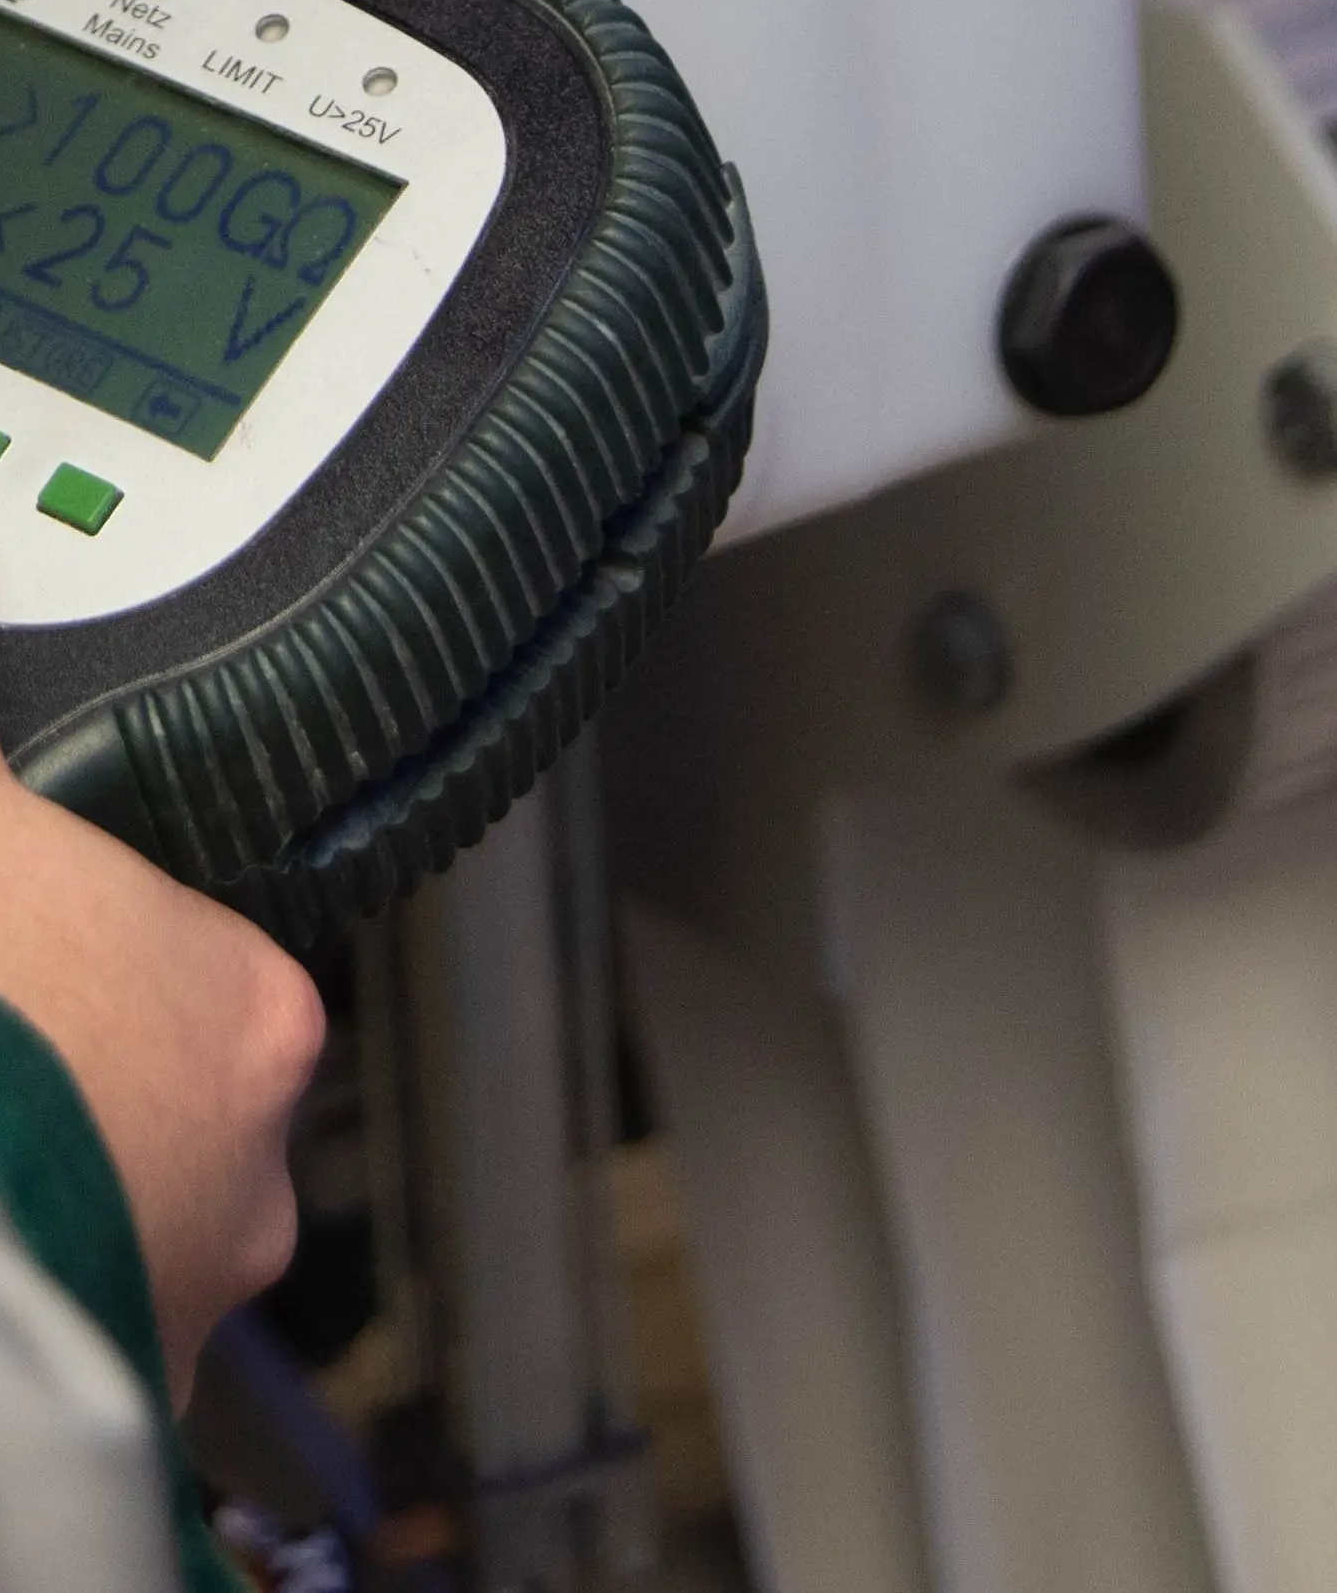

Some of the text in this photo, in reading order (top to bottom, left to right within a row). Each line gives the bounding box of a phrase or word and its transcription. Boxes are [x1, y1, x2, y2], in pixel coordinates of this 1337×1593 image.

[82, 13, 161, 60] Mains
[201, 49, 284, 95] LIMIT
[308, 93, 402, 145] U>25V
[222, 275, 308, 366] V
